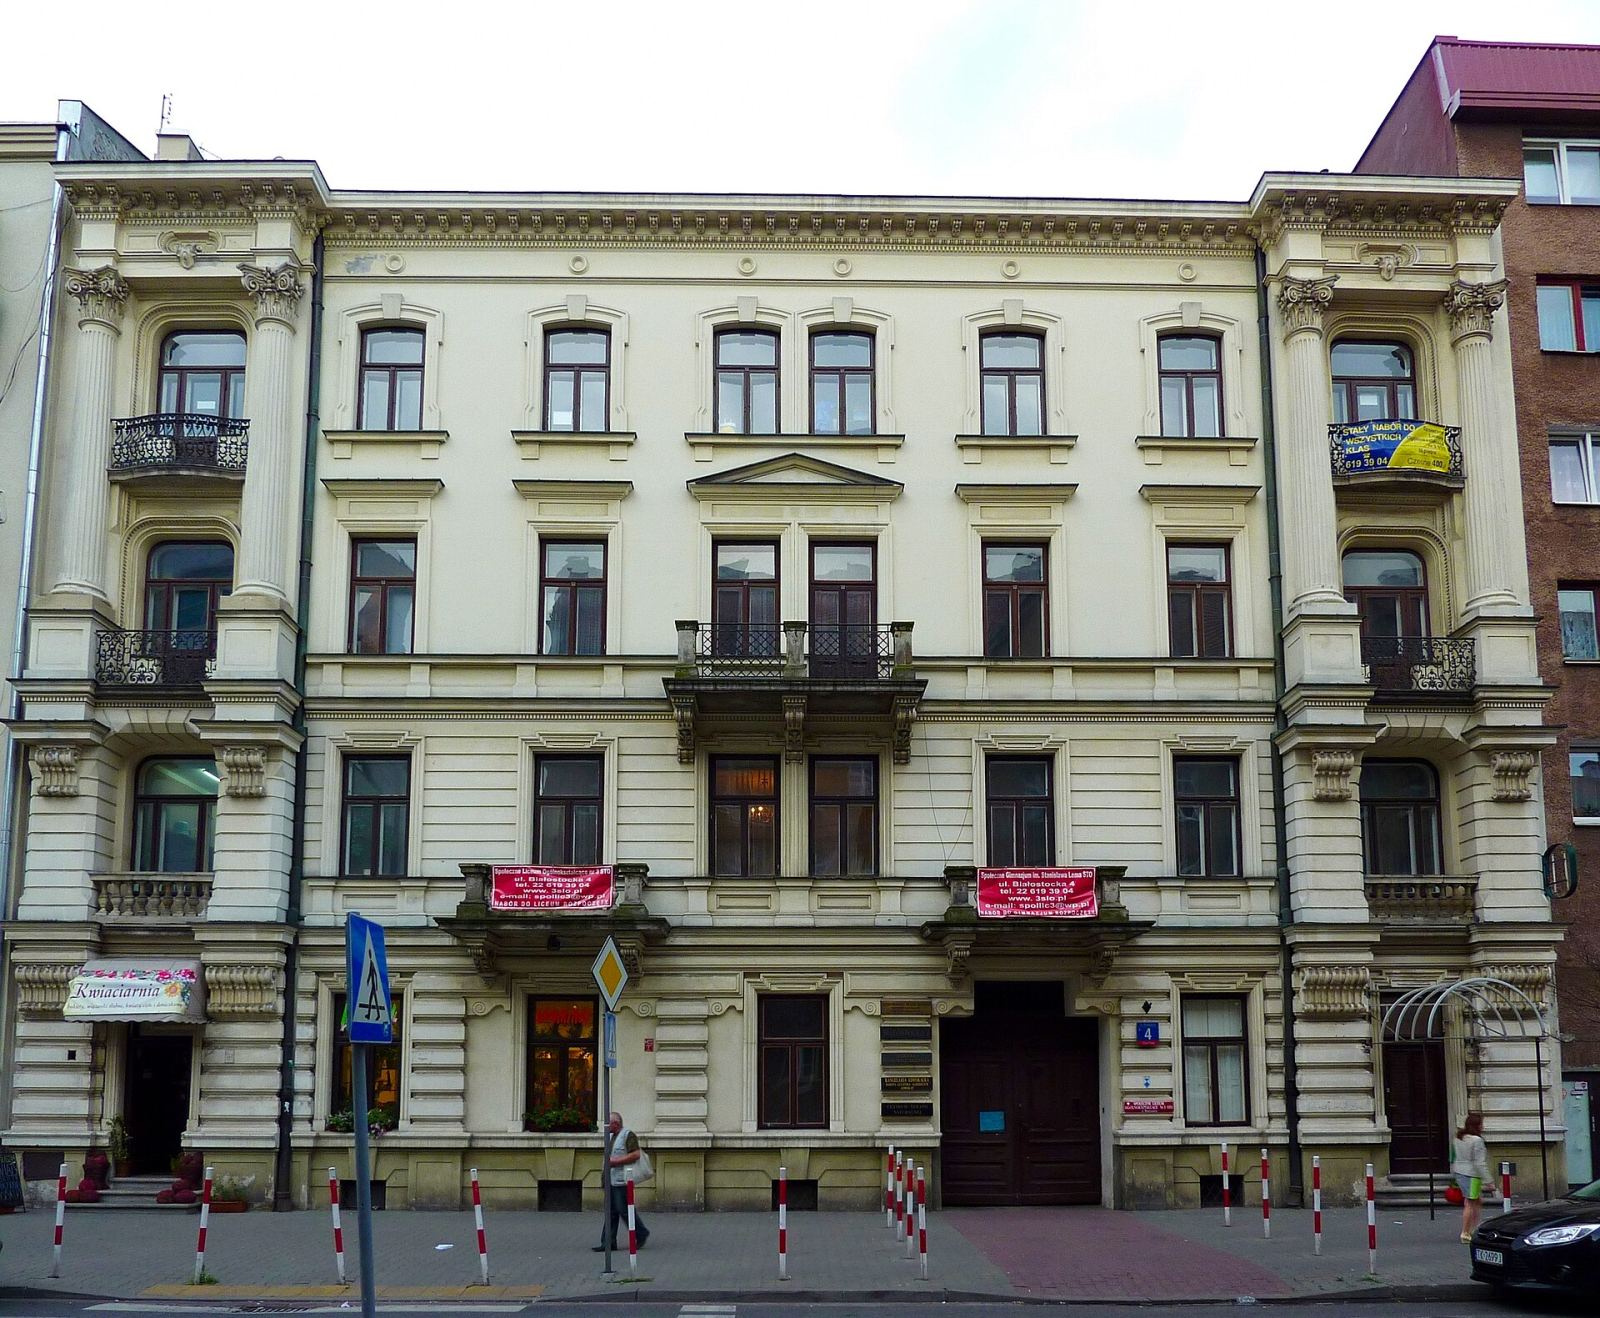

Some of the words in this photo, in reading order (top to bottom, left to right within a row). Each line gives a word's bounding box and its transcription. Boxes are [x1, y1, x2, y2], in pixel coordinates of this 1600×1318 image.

[1343, 425, 1369, 436] STAŁY
[1373, 422, 1402, 431] NABÓR
[1346, 433, 1402, 445] WSZYSTKICH
[1346, 445, 1370, 454] KLAS
[1346, 460, 1361, 469] 619
[1364, 458, 1374, 466] 39
[1377, 457, 1387, 465] 04
[70, 983, 160, 999] Kwiaciarnia
[1144, 1027, 1152, 1040] 4
